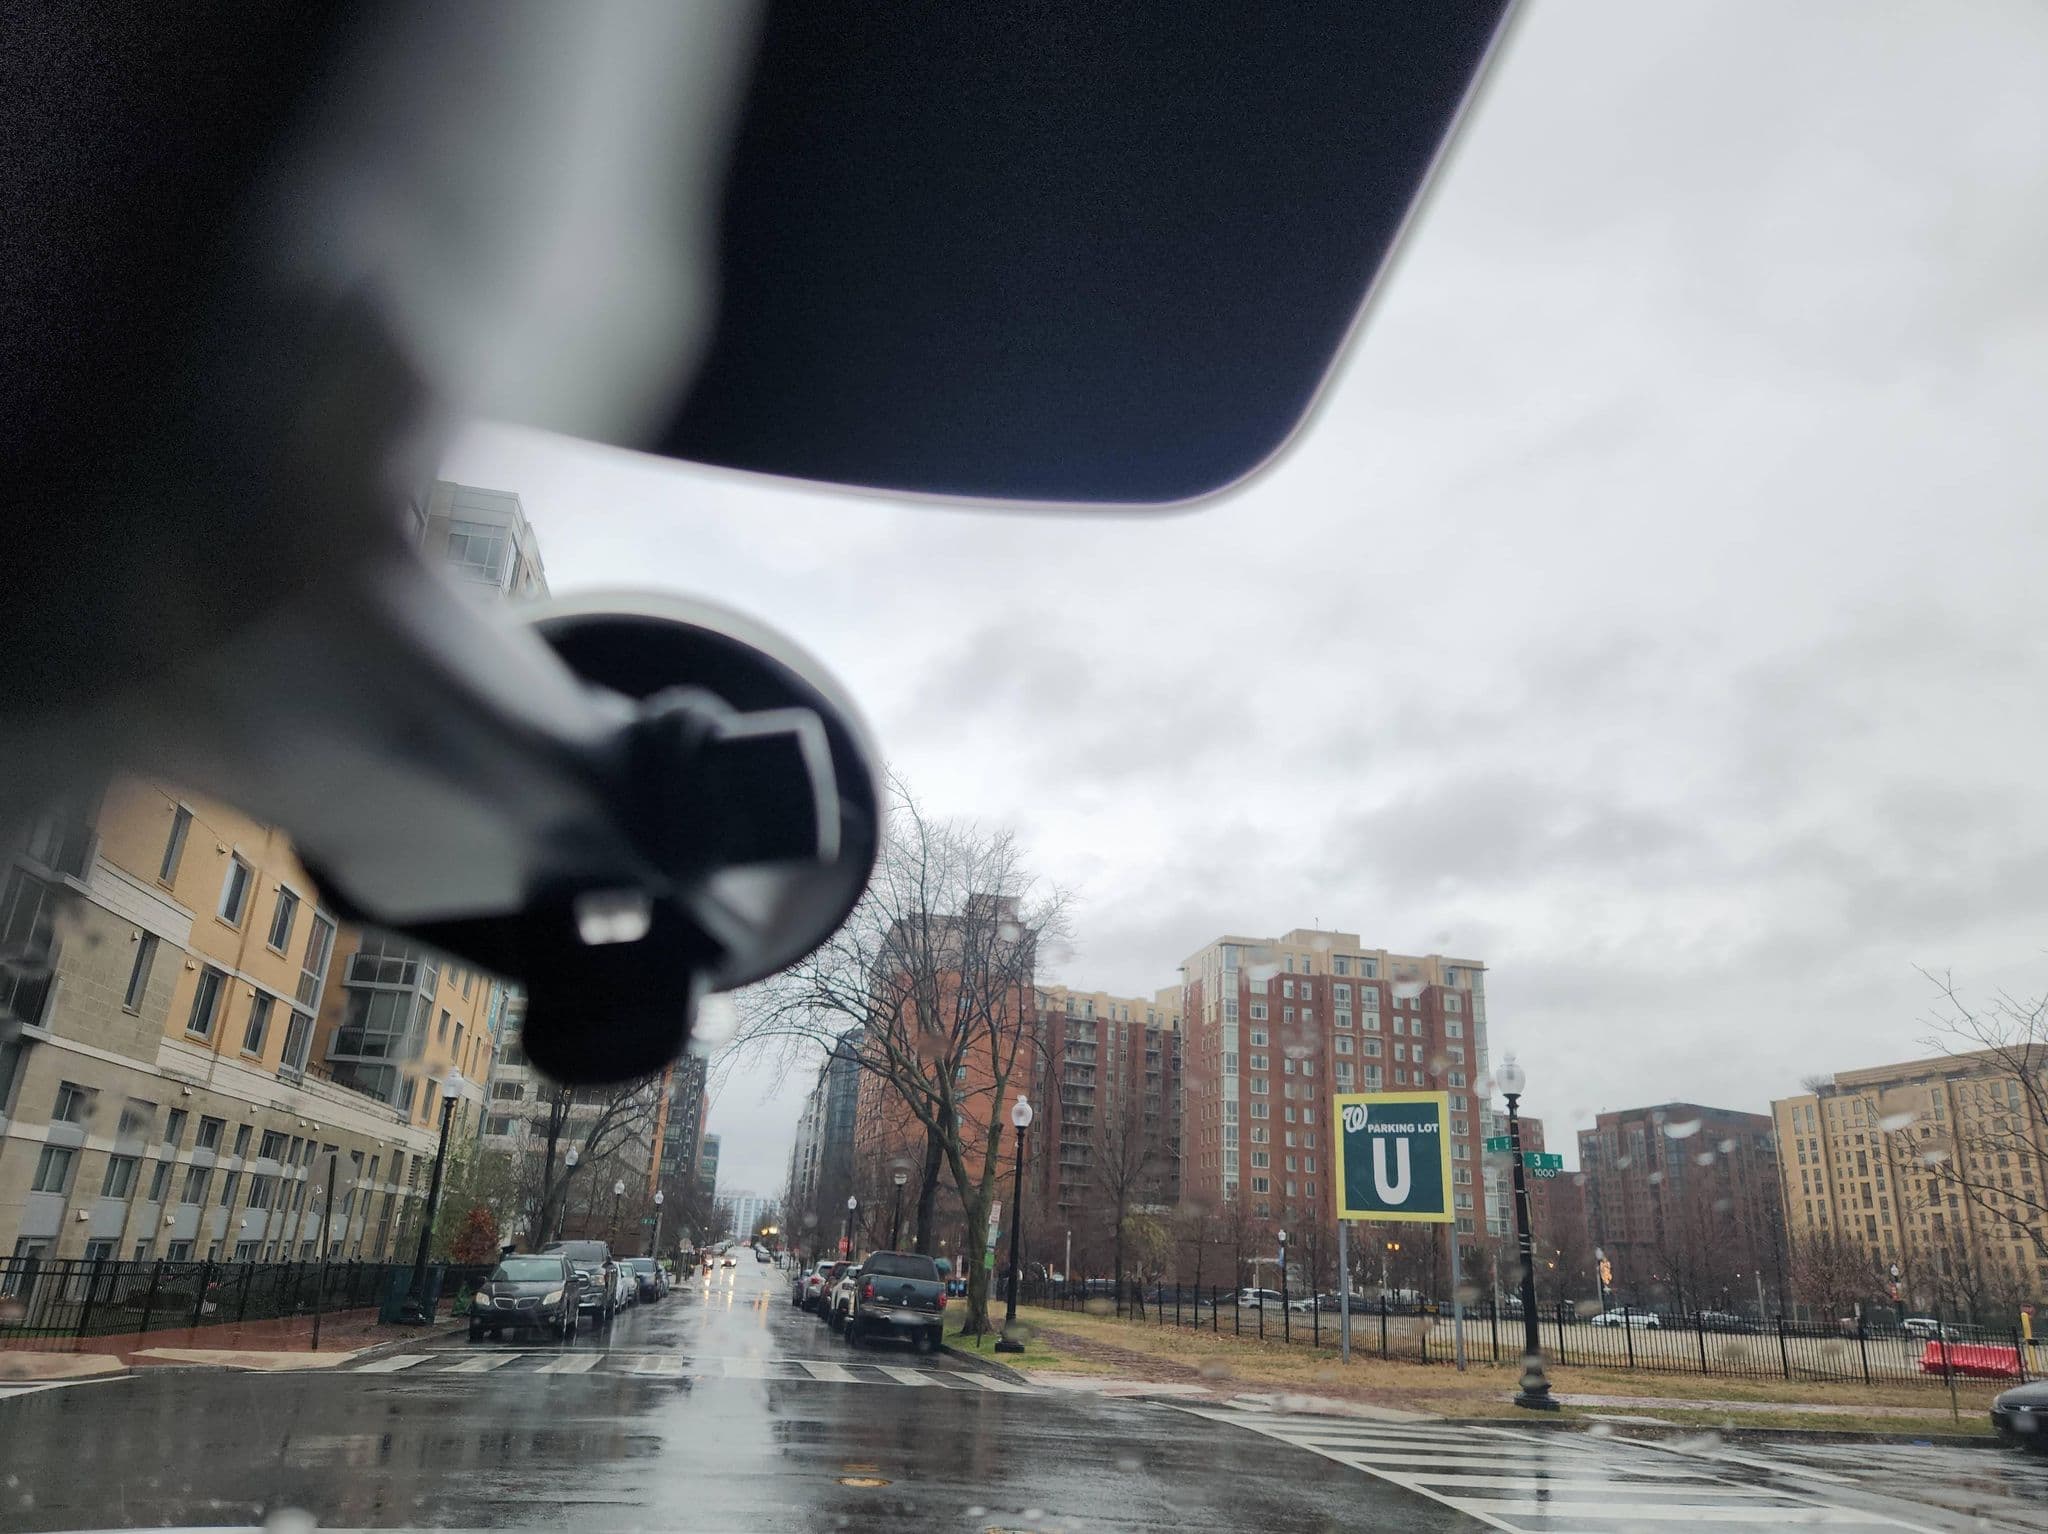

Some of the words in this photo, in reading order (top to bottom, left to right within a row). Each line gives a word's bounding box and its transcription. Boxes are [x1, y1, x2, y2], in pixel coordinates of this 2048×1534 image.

[1368, 1123, 1415, 1133] PARKING
[1418, 1123, 1439, 1133] LOT
[1534, 1154, 1541, 1166] 3
[1372, 1137, 1411, 1205] U
[1534, 1169, 1555, 1178] 1000
